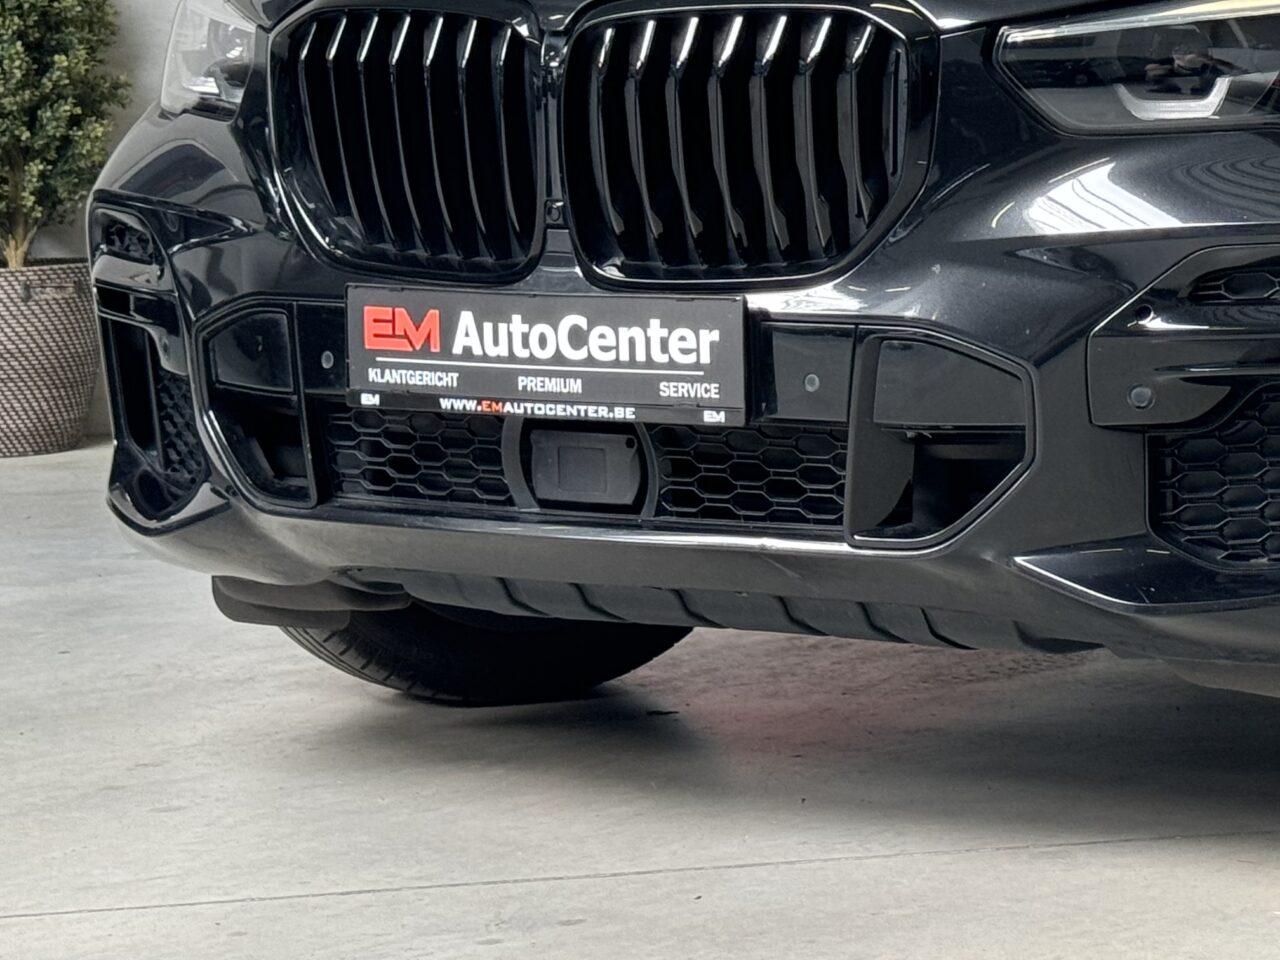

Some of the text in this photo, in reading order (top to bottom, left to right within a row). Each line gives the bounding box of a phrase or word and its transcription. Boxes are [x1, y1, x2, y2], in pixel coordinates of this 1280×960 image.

[363, 305, 720, 364] EM AutoCenter
[368, 367, 720, 399] KLANTGERICHT PREMIUM SERVICE
